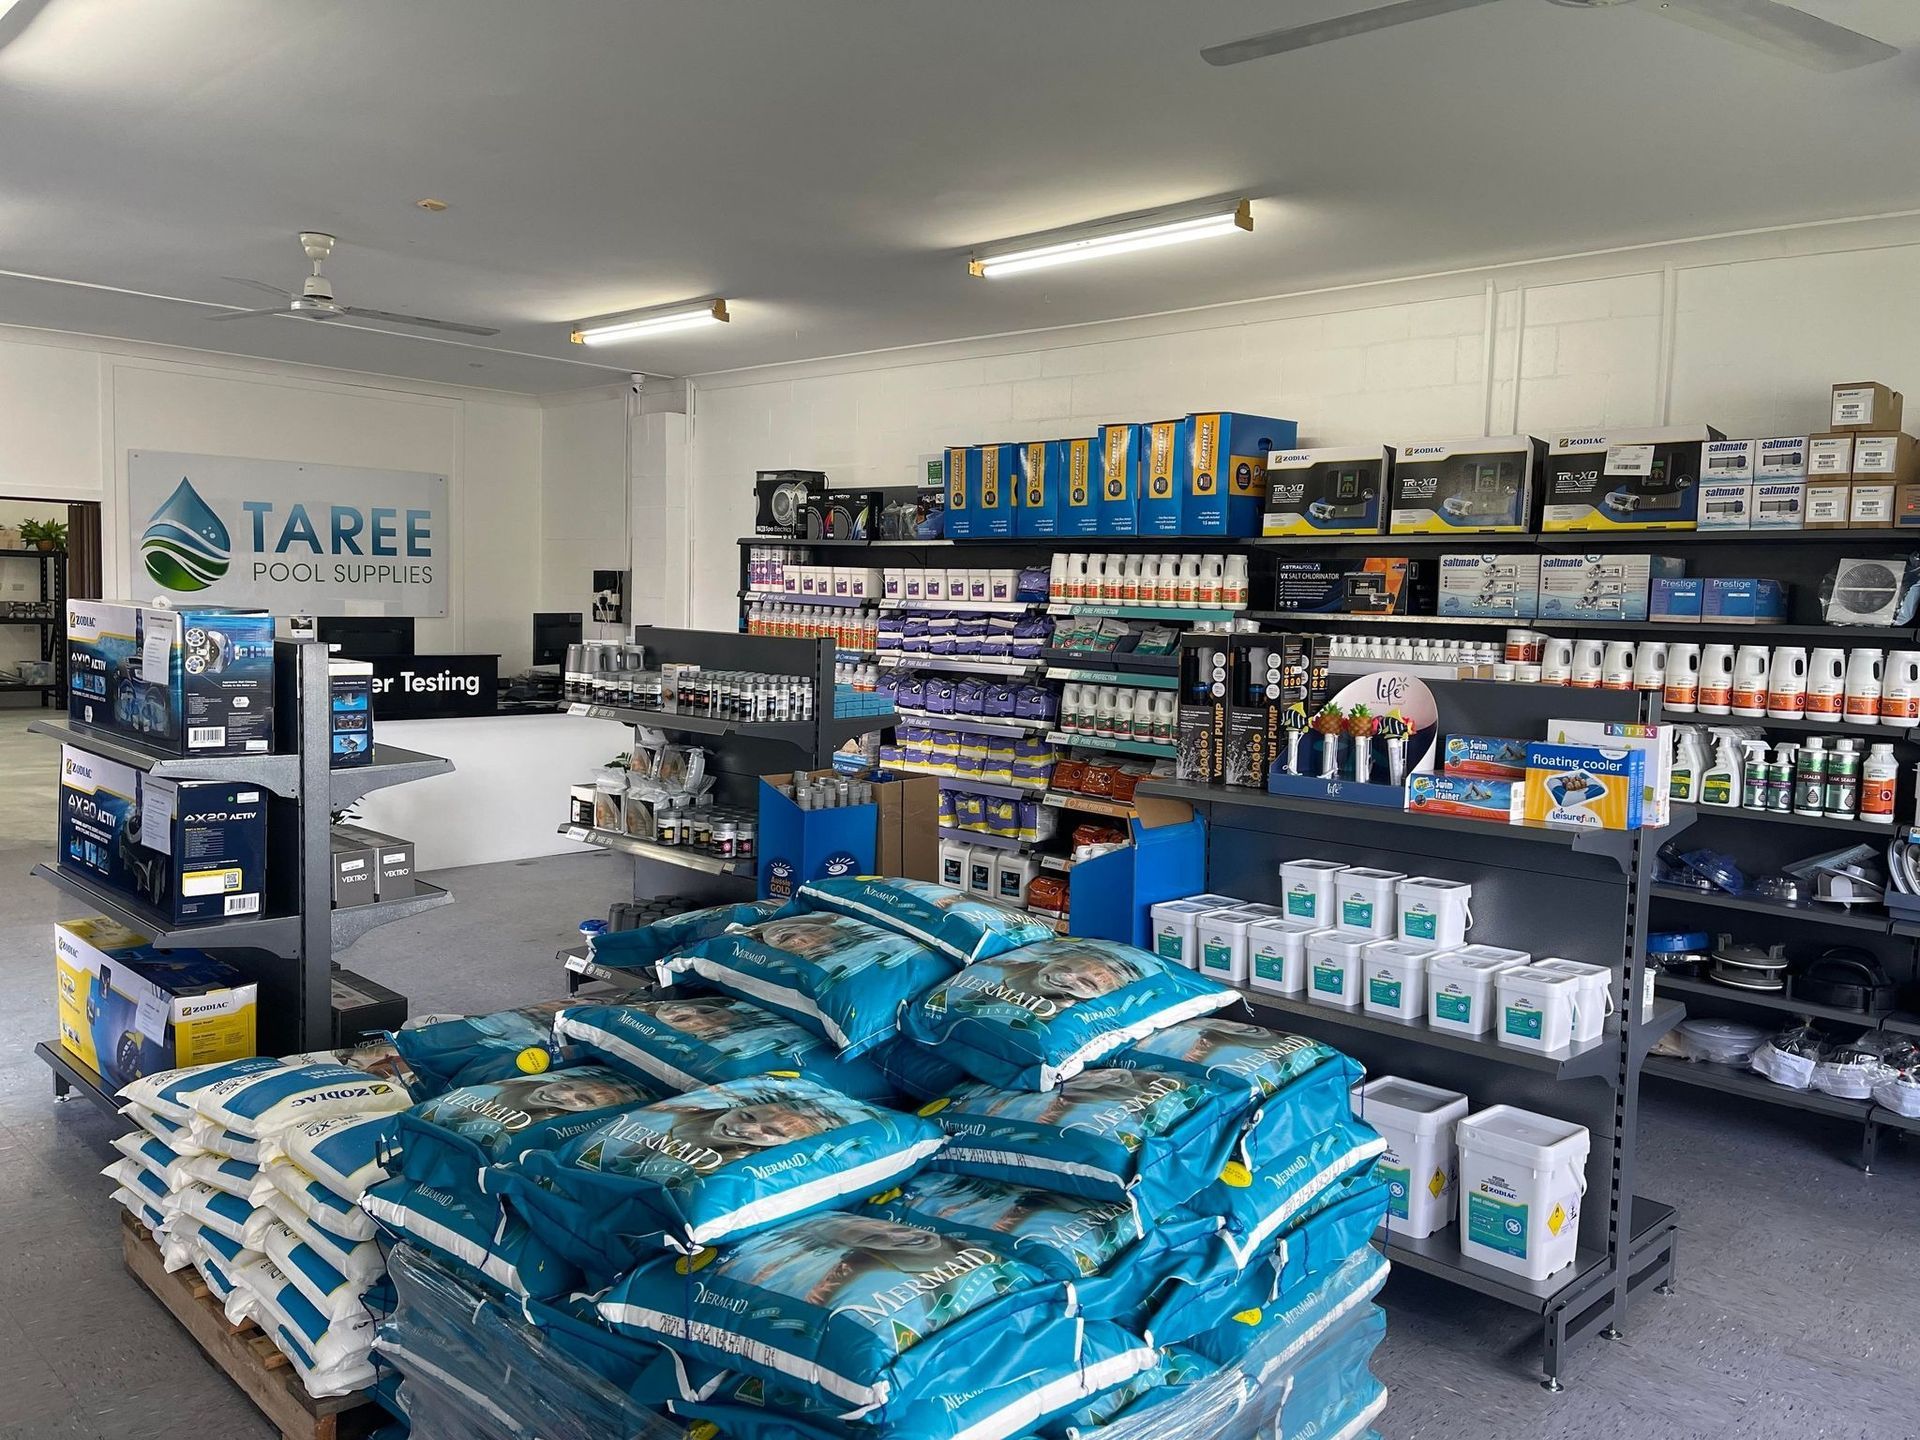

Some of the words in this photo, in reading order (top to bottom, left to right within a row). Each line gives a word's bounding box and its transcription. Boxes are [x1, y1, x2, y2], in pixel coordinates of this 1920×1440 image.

[1199, 422, 1209, 471] Premier
[1569, 436, 1606, 446] ZODIAC
[1708, 441, 1747, 452] saltmate
[1761, 438, 1803, 449] saltmate
[1109, 431, 1118, 478] Premier
[1154, 427, 1165, 475] Premier
[1282, 454, 1310, 462] ZODIAC
[1413, 446, 1444, 455] ZODIAC
[1705, 486, 1745, 497] saltmate
[1759, 485, 1800, 496] saltmate
[243, 501, 433, 558] TAREE
[1442, 557, 1480, 568] saltmate
[1543, 557, 1583, 568] saltmate
[253, 562, 326, 584] POOL
[334, 563, 433, 585] SUPPLIES
[1301, 573, 1339, 581] CHLORINATOR
[1660, 579, 1697, 590] Prestige
[1712, 579, 1751, 590] Prestige
[401, 670, 480, 695] Testing
[1376, 677, 1402, 706] life
[1215, 702, 1225, 732] PUMP
[1268, 705, 1278, 737] PUMP
[1605, 725, 1655, 738] INTEX
[1469, 740, 1488, 751] Swim
[1213, 735, 1223, 777] Venturi
[1469, 750, 1495, 762] Trainer
[1532, 754, 1579, 771] floating
[1582, 759, 1623, 772] cooler
[1327, 782, 1343, 797] life
[1435, 779, 1454, 790] Swim
[1434, 789, 1461, 801] Trainer
[68, 793, 97, 818] AX20
[184, 812, 228, 823] AX20
[1552, 808, 1597, 823] leisurefun
[341, 873, 369, 883] VEXTRO
[384, 868, 410, 878] VEXTRO
[770, 885, 791, 895] GOLD
[731, 941, 768, 966] MERMAID
[192, 1000, 229, 1014] ZODIAC
[977, 1005, 1032, 1020] FINEST
[618, 1009, 657, 1037] MERMAID
[1206, 1035, 1319, 1081] MERMAID
[291, 1086, 370, 1107] ZODIAC
[438, 1087, 533, 1131] MERMAID
[1060, 1077, 1183, 1137] MERMAID
[938, 1118, 987, 1137] MERMAID
[600, 1113, 723, 1171] MERMAID
[742, 1152, 807, 1182] MERMAID
[1264, 1154, 1308, 1191] MERMAID
[1488, 1186, 1518, 1200] ZODIAC
[1013, 1199, 1134, 1251] MERMAI
[828, 1246, 997, 1331] MERMAID
[694, 1281, 749, 1316] MERMAID
[1273, 1292, 1319, 1328] MERMAID
